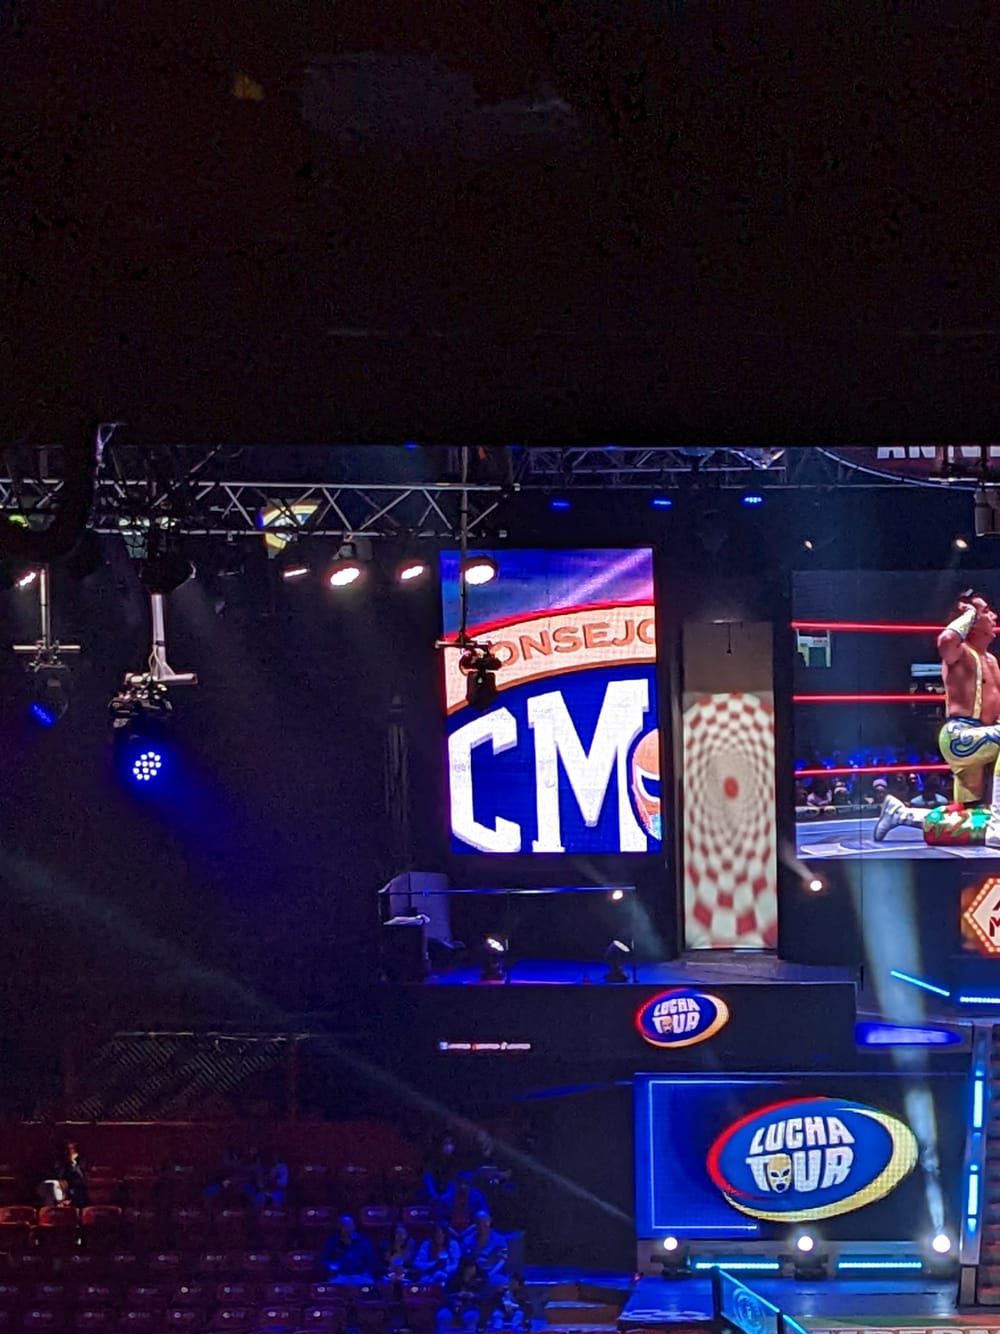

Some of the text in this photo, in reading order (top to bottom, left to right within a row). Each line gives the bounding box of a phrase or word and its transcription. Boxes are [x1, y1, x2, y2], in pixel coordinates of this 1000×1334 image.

[476, 619, 657, 672] ONSEJO
[653, 998, 700, 1016] LUCHA
[749, 1116, 855, 1155] LUCHA
